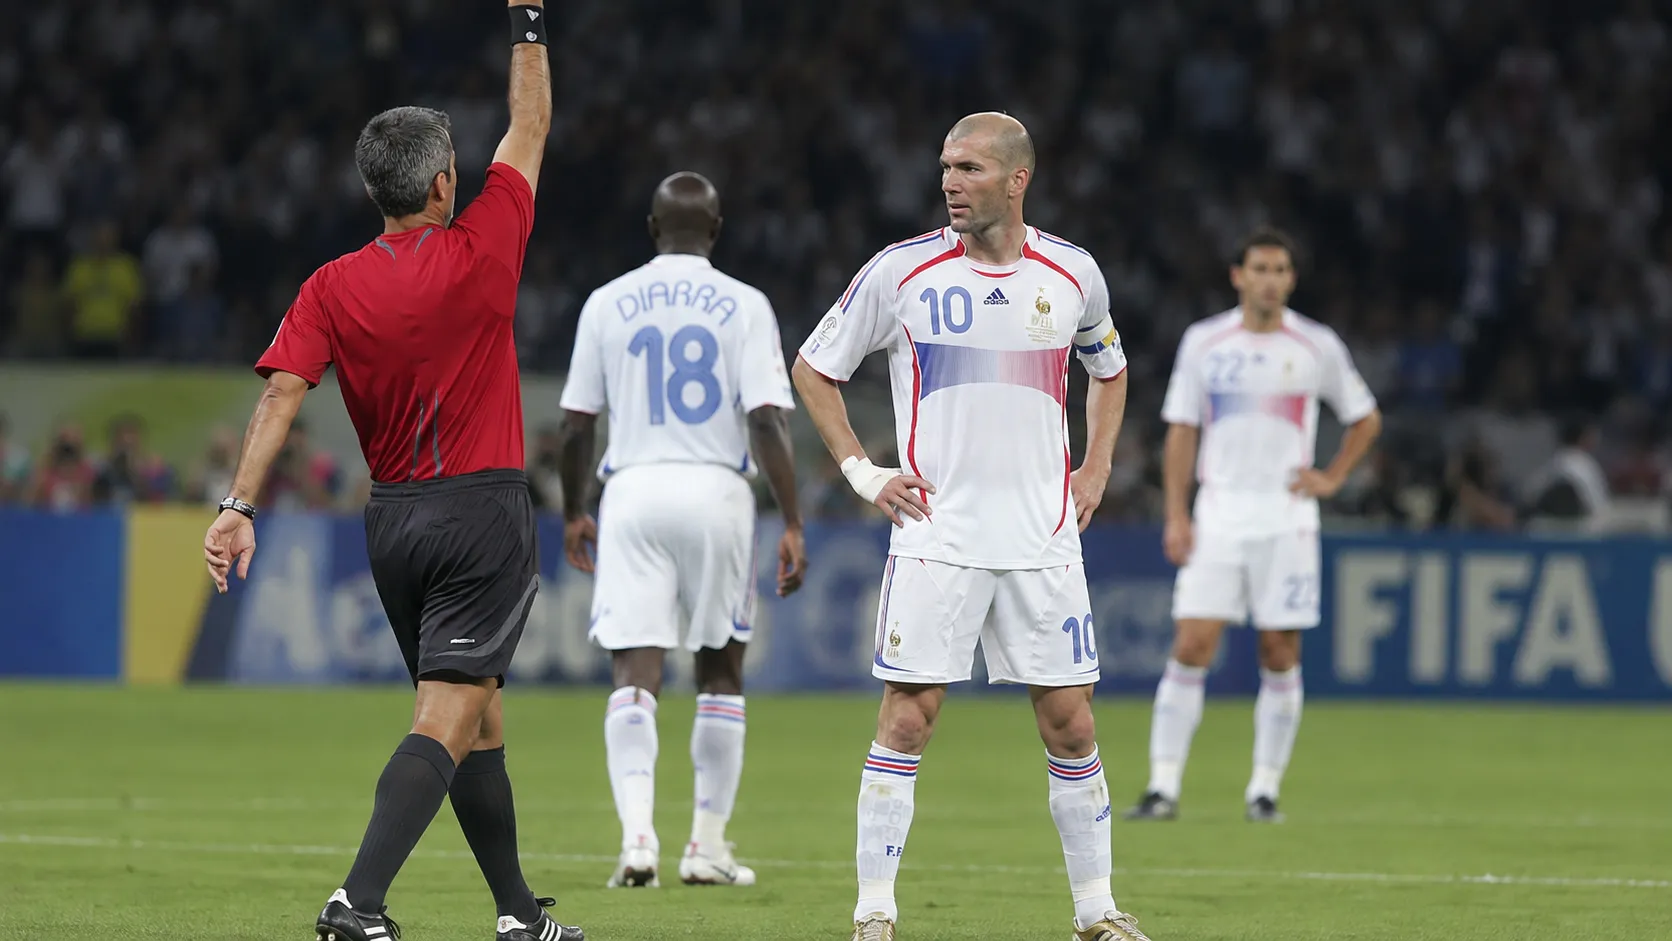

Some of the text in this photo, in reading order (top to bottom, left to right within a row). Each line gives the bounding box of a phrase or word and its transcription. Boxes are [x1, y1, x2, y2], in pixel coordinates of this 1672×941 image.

[616, 280, 738, 327] DIARRA
[919, 285, 974, 336] 10
[627, 325, 723, 426] 18
[1061, 612, 1097, 665] 10
[1334, 549, 1614, 688] FIFA
